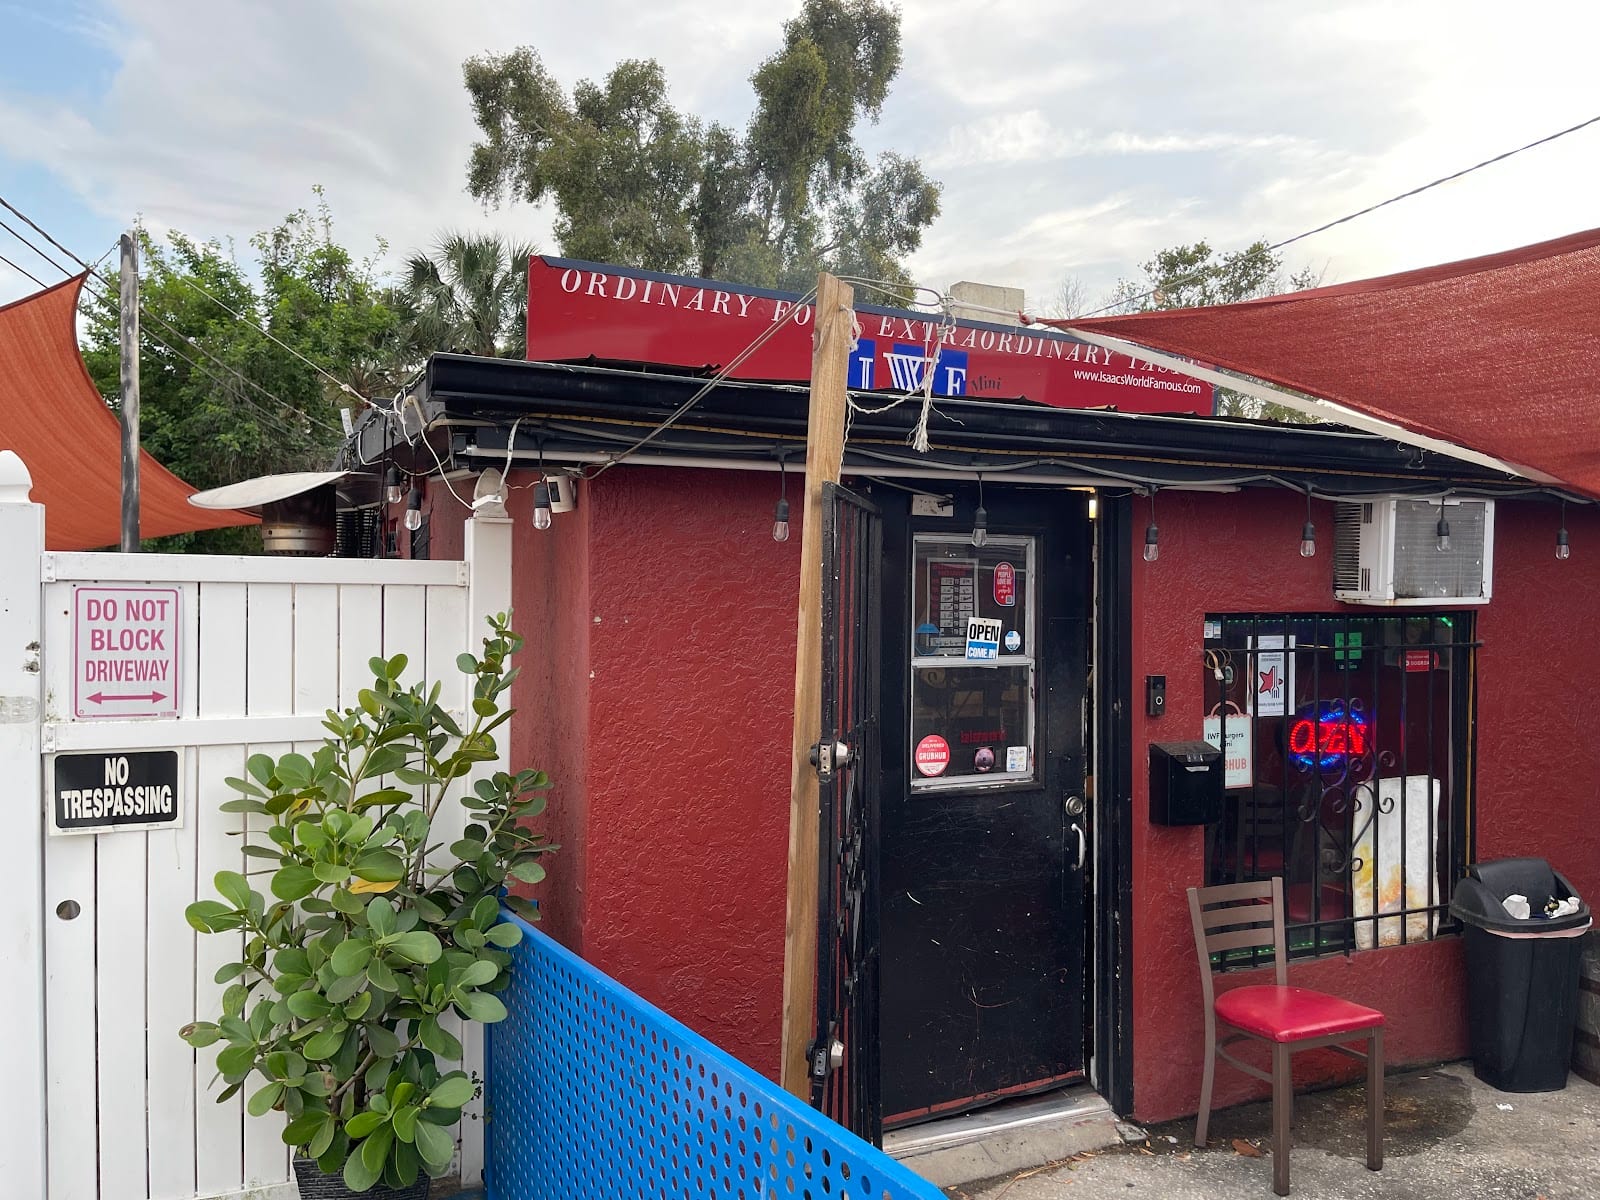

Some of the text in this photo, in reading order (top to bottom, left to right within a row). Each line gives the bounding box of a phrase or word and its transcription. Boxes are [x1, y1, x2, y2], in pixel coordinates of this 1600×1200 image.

[561, 269, 756, 317] ORDINARY
[877, 316, 1114, 366] EXTRAORDINARY
[971, 375, 1002, 392] Mini
[1074, 369, 1201, 394] www.IsaacsWorldFamous.com
[87, 599, 169, 622] DO NOT
[91, 629, 165, 652] BLOCK
[969, 623, 1000, 642] OPEN
[968, 647, 988, 659] COME
[988, 648, 997, 659] IN
[85, 659, 169, 682] DRIVEWAY
[1207, 732, 1244, 740] IWF urgers
[1290, 719, 1367, 754] OPEN
[919, 752, 947, 760] GRUBHUB
[104, 756, 130, 786] NO
[60, 784, 172, 819] TRESPASSING
